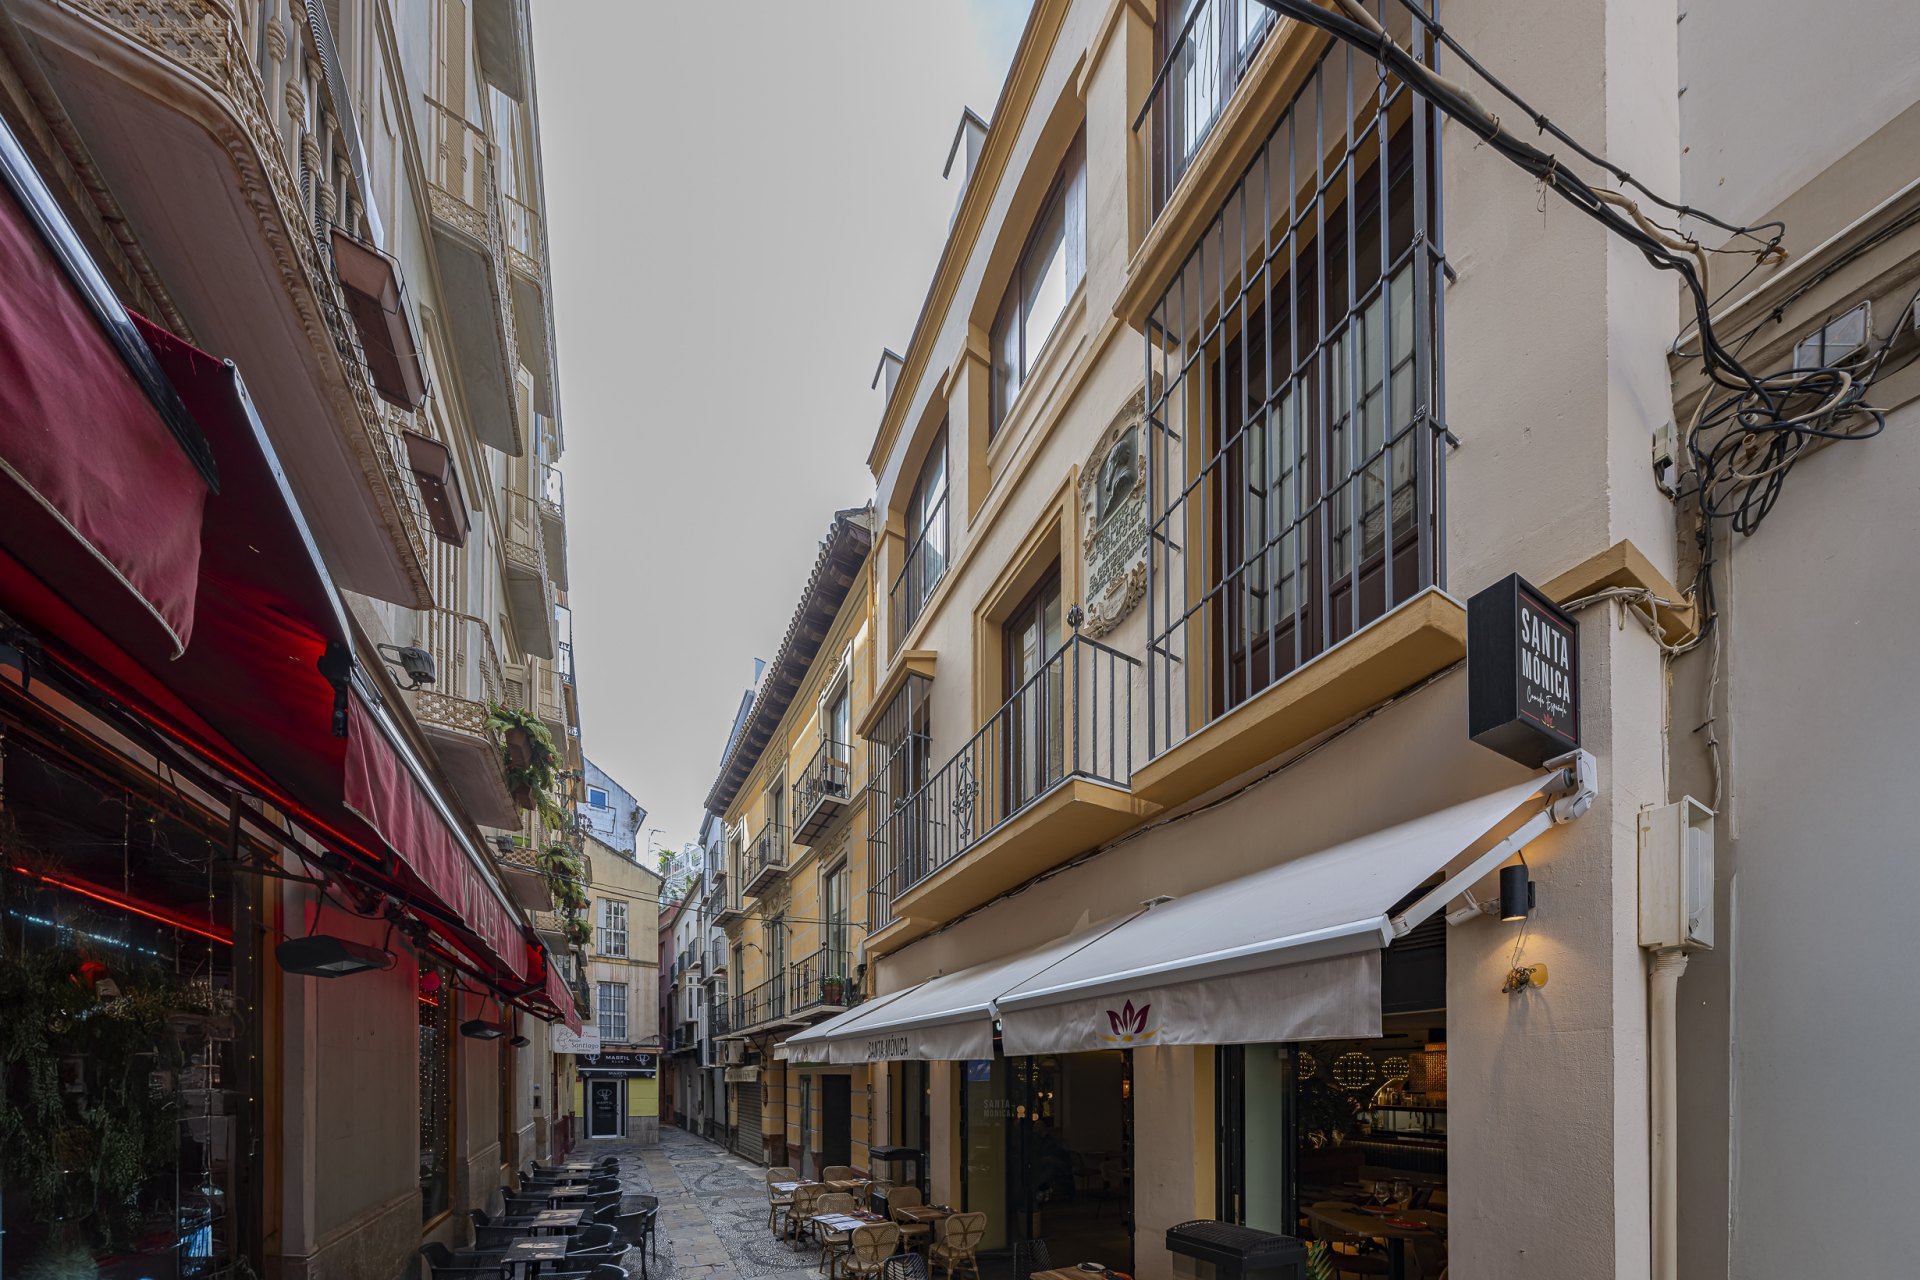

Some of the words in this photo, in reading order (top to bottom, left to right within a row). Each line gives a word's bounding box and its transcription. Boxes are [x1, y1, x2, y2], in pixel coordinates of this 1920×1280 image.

[1521, 607, 1569, 670] SANTA
[1522, 647, 1570, 704] MÓNICA
[571, 1042, 599, 1050] Santiago
[868, 1041, 884, 1059] SANTA
[885, 1034, 908, 1056] MÓNICA
[983, 1099, 1010, 1109] SANTA
